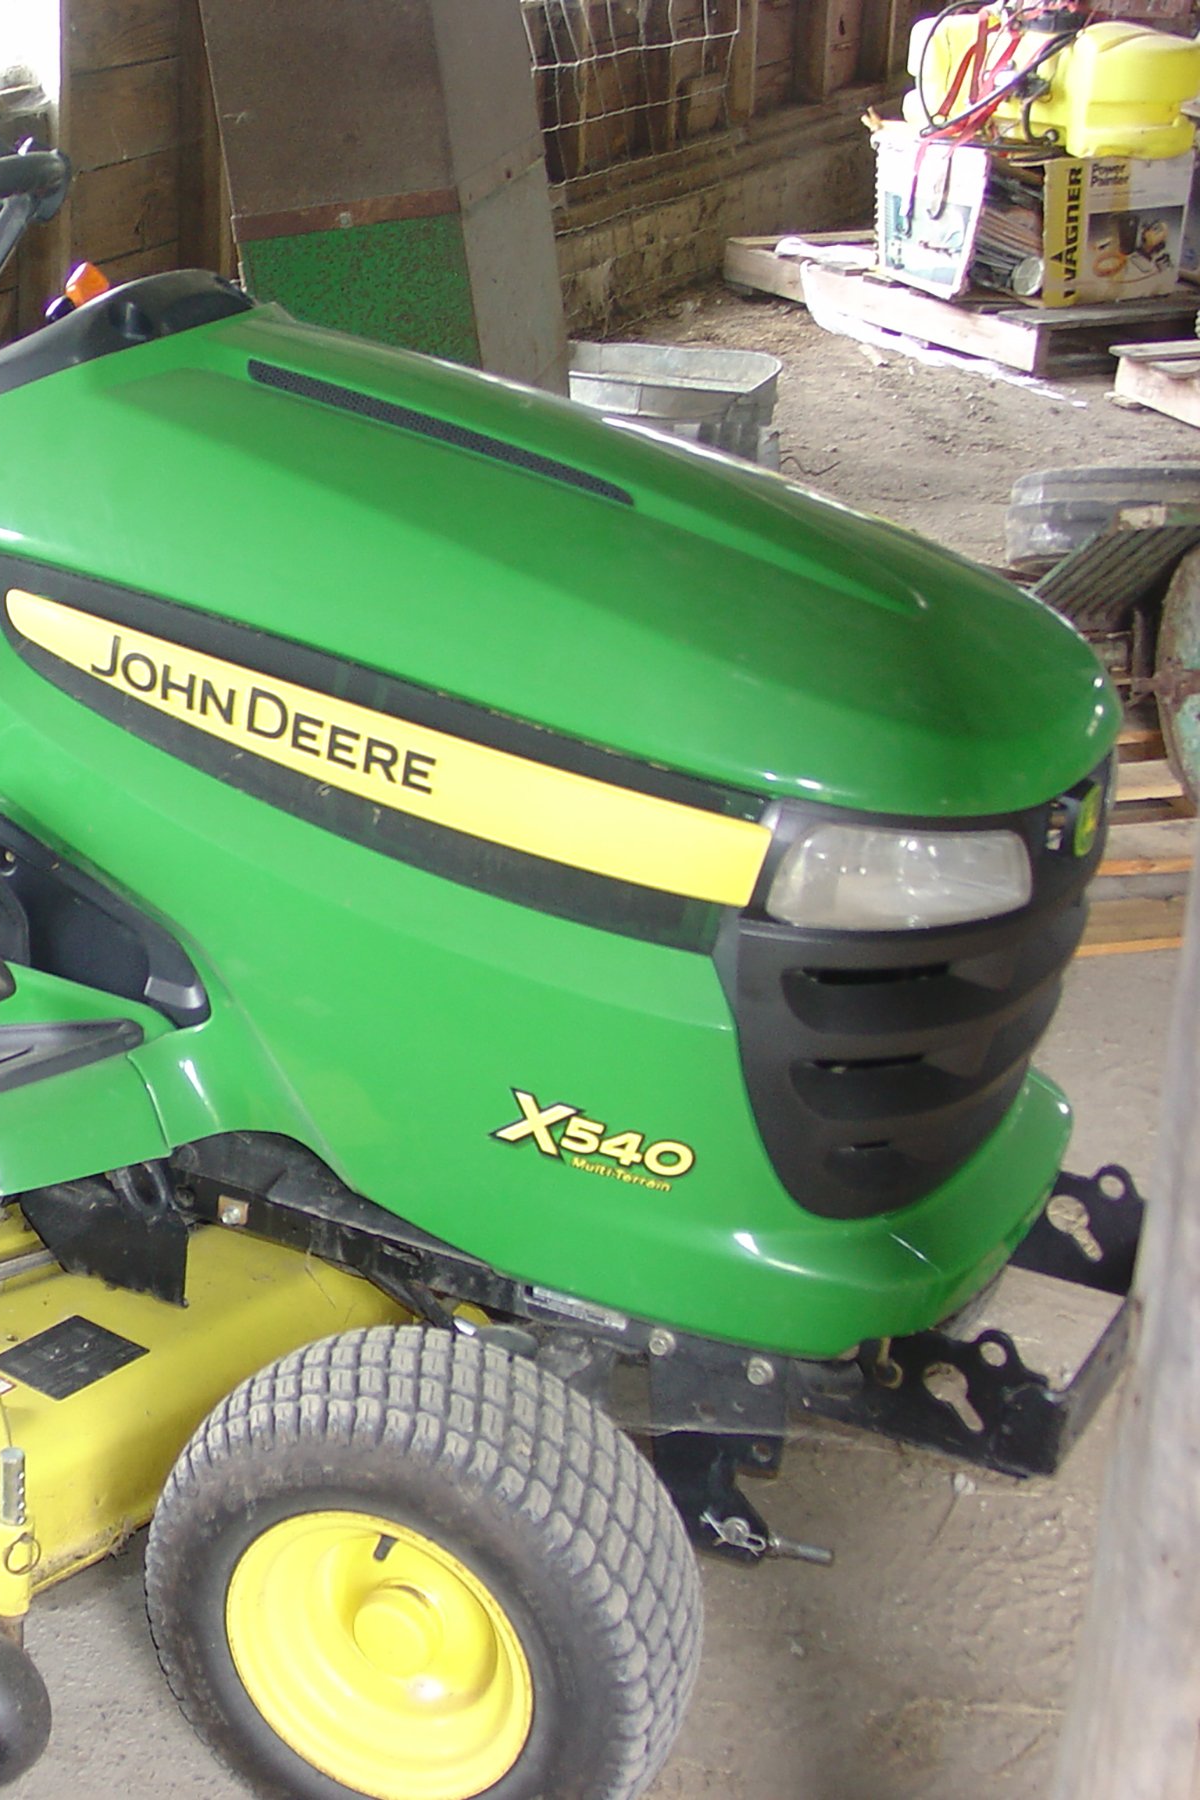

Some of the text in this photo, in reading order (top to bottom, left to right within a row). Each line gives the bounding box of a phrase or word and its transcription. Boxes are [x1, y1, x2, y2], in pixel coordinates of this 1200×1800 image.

[1092, 163, 1126, 175] Power
[1054, 167, 1083, 299] WAGNER
[91, 635, 436, 794] JOHN DEERE
[489, 1087, 696, 1177] X540
